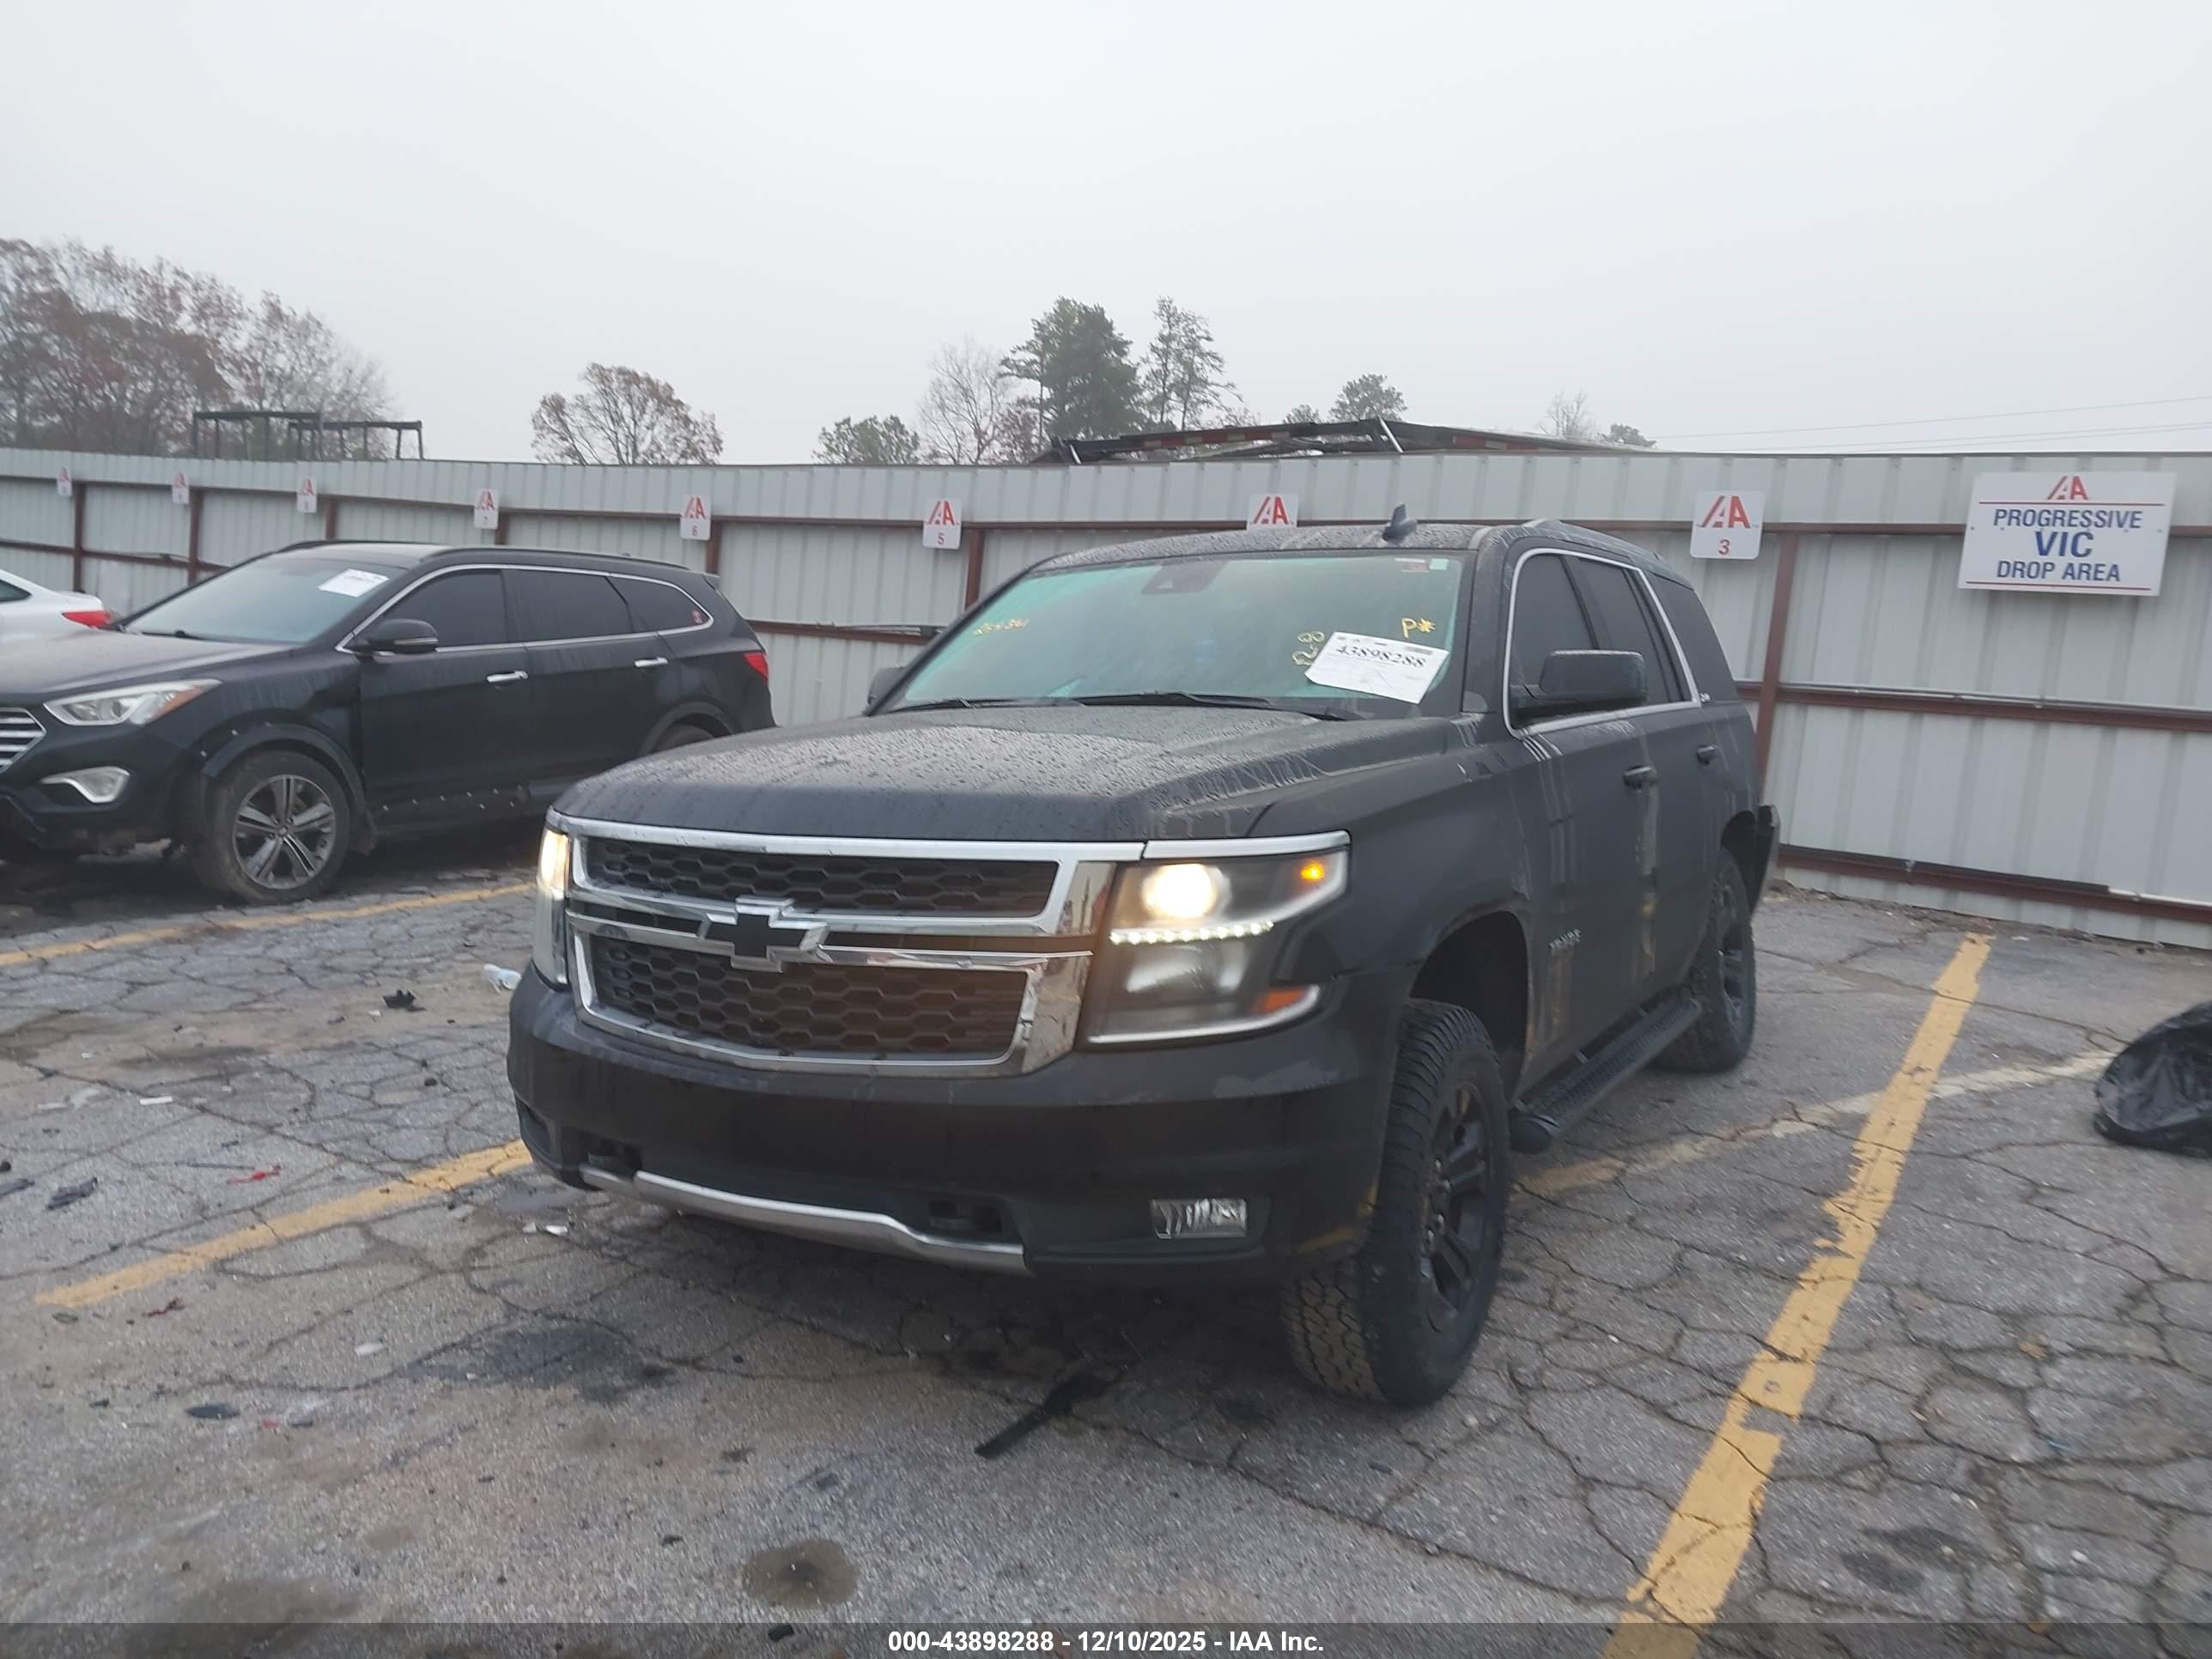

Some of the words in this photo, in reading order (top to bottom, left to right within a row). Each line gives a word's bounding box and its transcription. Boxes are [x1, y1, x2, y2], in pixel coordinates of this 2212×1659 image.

[1993, 508, 2143, 529] PROGRESSIVE
[937, 532, 945, 545] 5
[1718, 538, 1731, 556] 3
[2034, 531, 2094, 558] VIC
[1996, 561, 2056, 580] DROP
[2062, 562, 2121, 583] AREA
